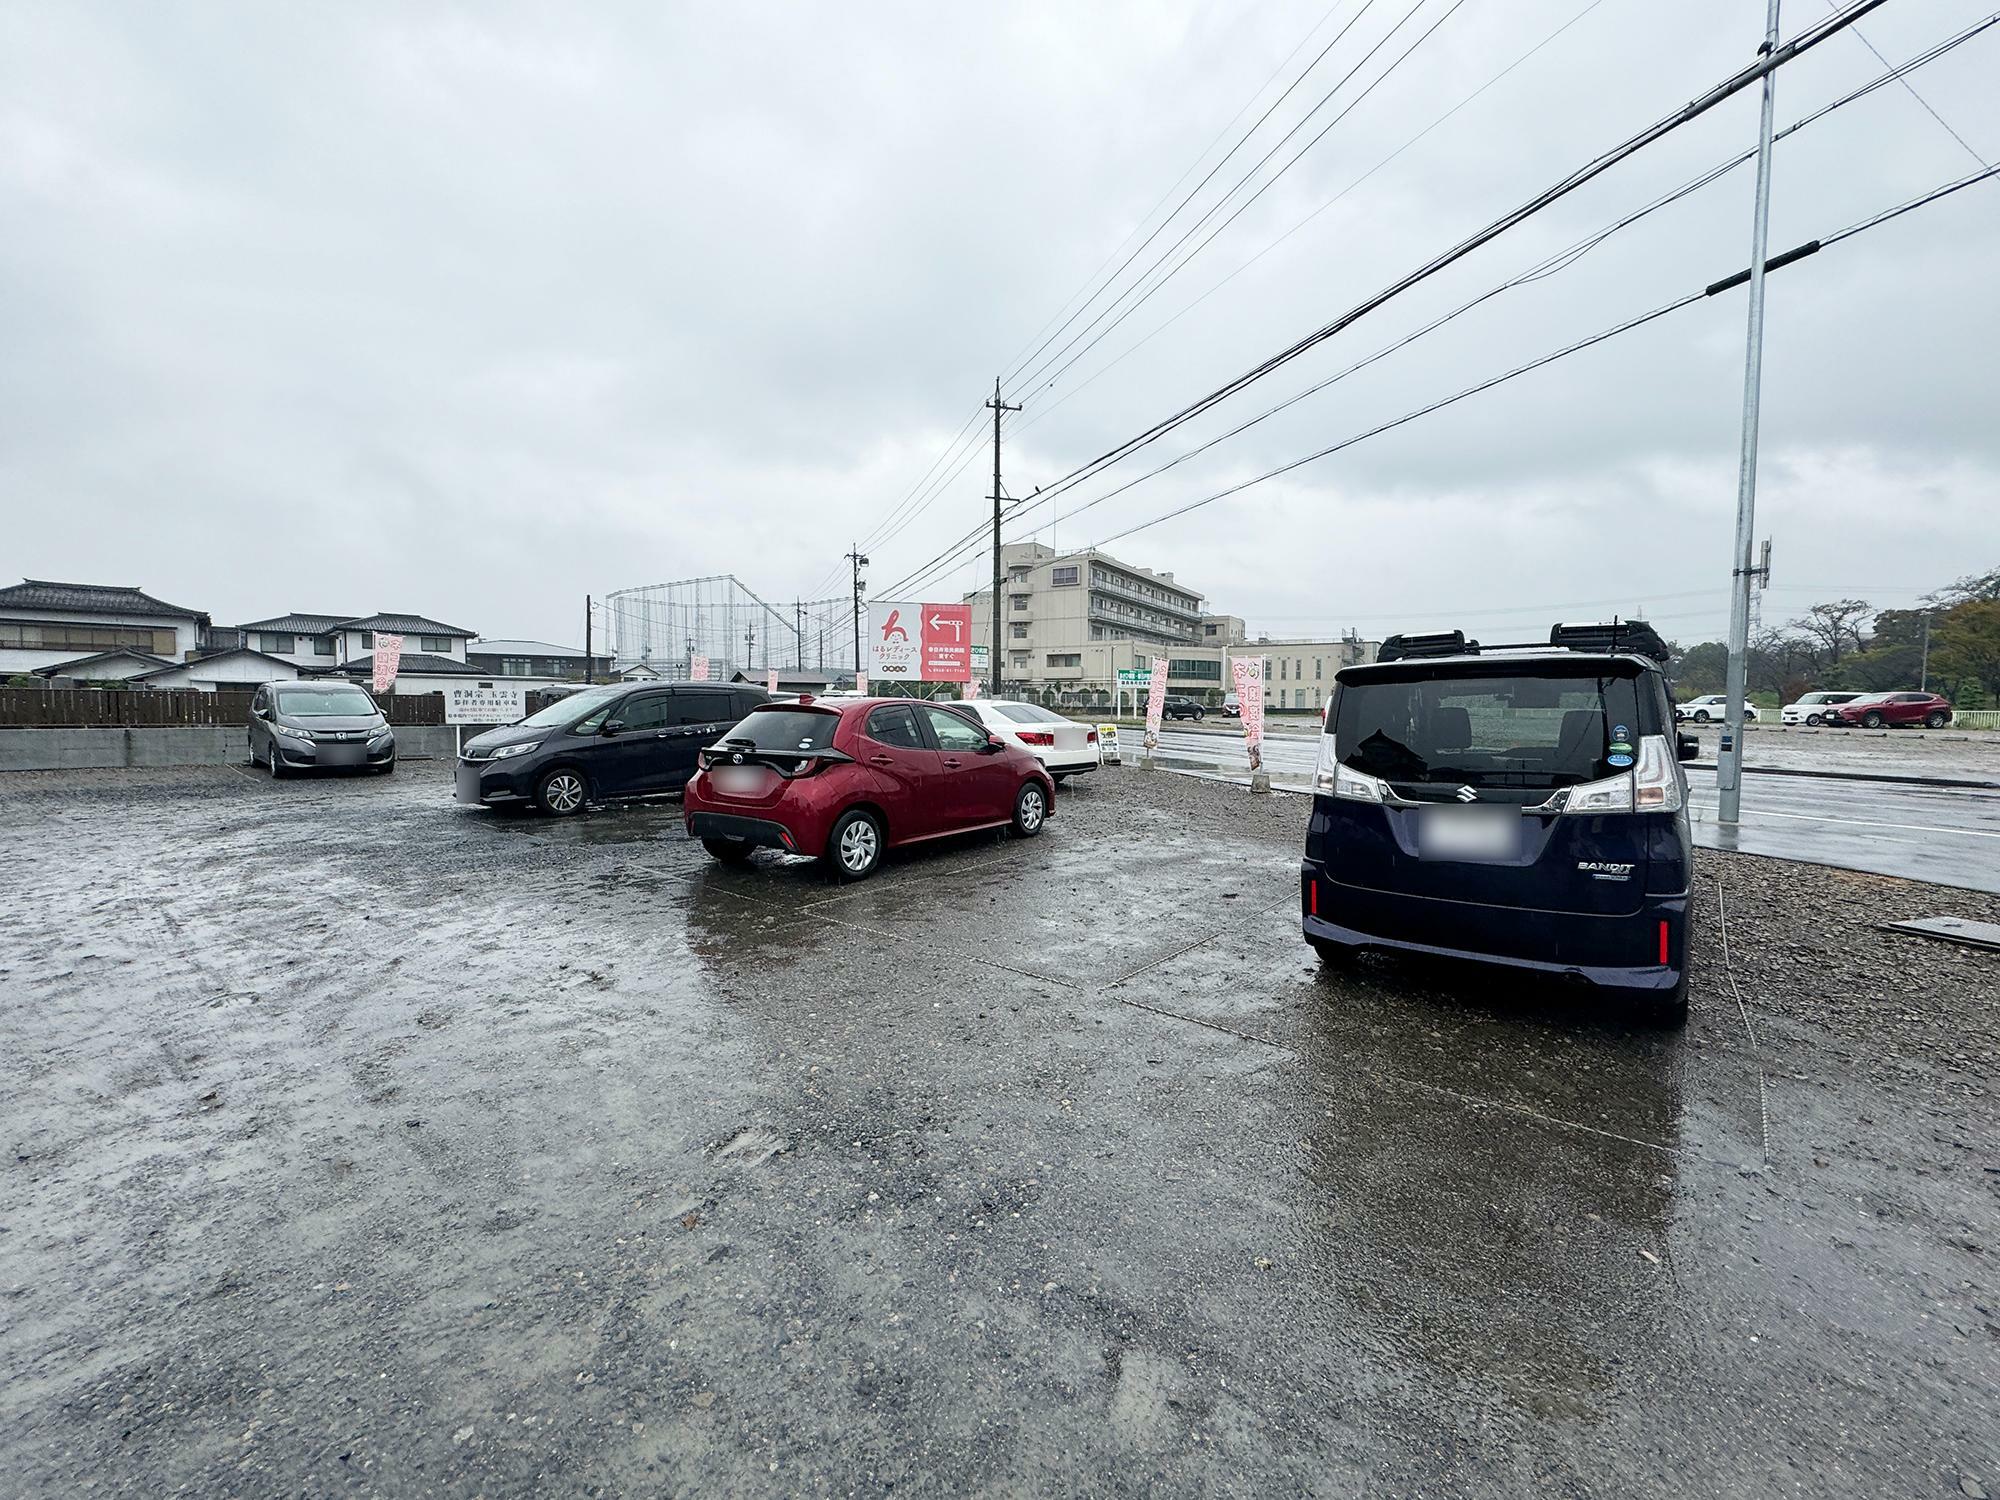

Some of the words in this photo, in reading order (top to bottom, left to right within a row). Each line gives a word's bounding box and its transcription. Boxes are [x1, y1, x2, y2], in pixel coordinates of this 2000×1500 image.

[872, 645, 918, 653] はるレディース
[879, 653, 910, 661] クリニック
[1578, 861, 1635, 871] BANDIT
